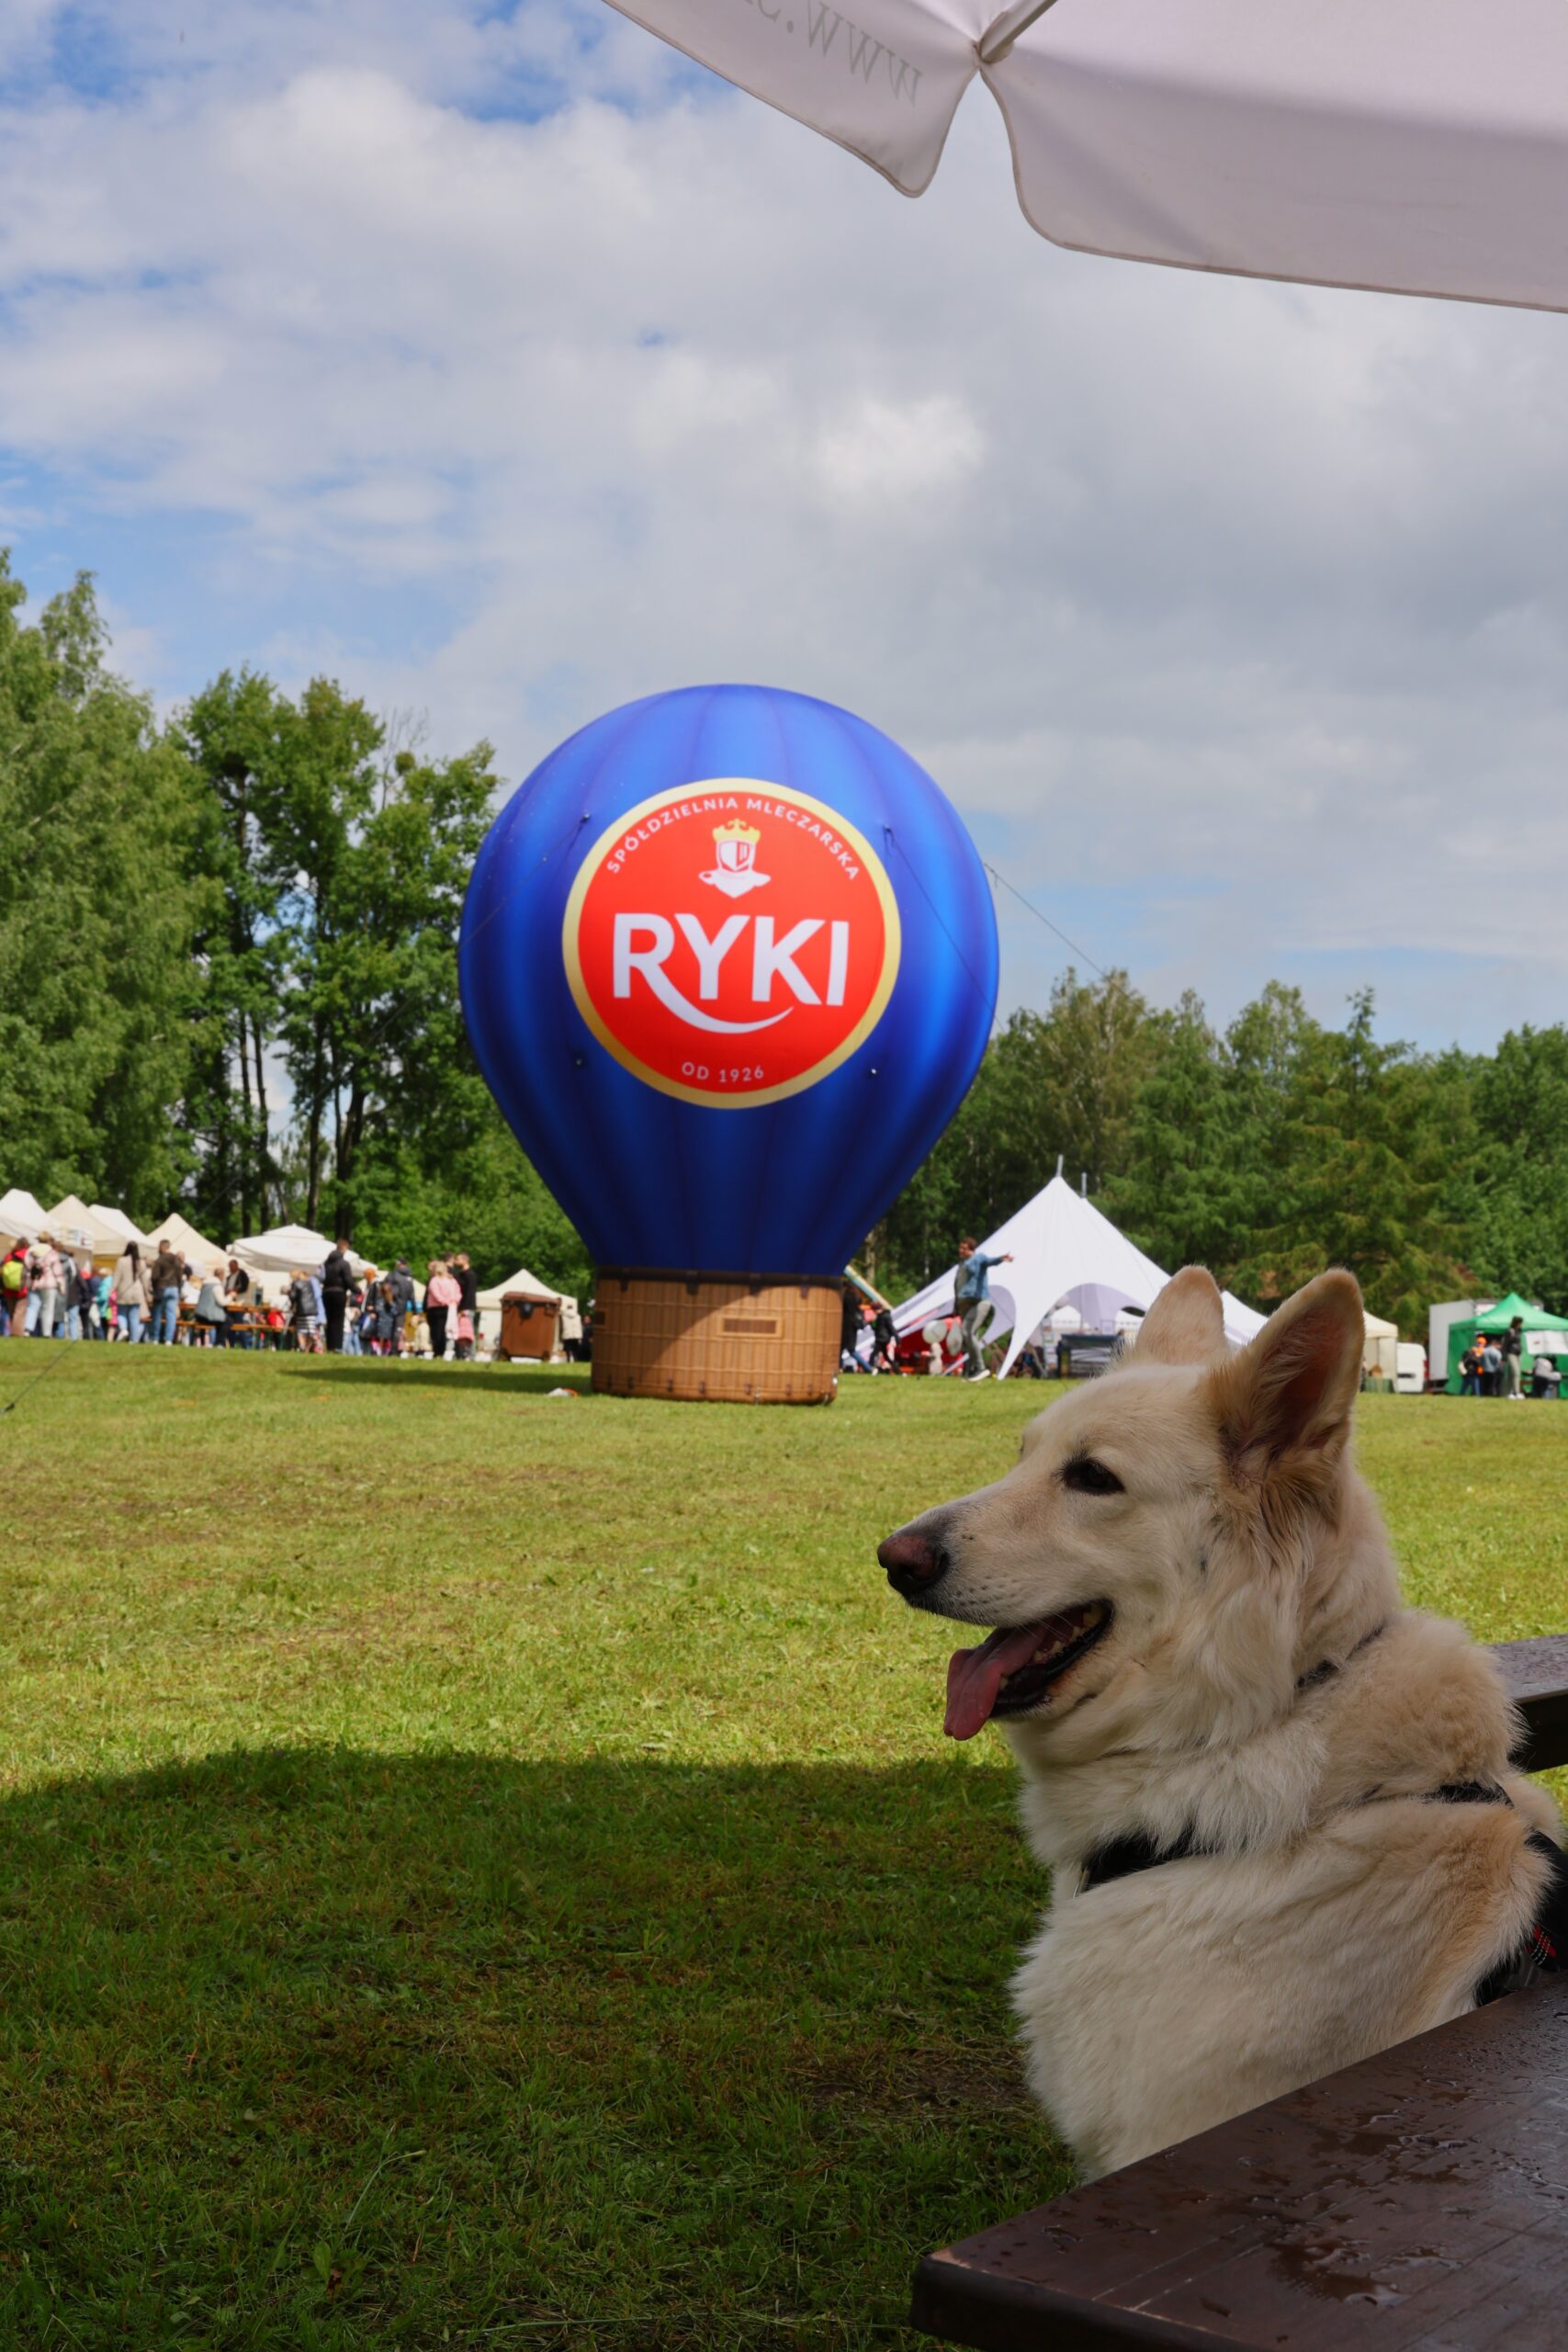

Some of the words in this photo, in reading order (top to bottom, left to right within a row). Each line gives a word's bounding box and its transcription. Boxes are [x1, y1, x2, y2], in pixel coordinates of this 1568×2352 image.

[606, 797, 739, 874] SPÓŁDZIELNIA
[747, 797, 860, 880] MLECZARSKA
[613, 912, 850, 1034] RYKI
[682, 1061, 709, 1080] OD
[719, 1064, 764, 1083] 1926
